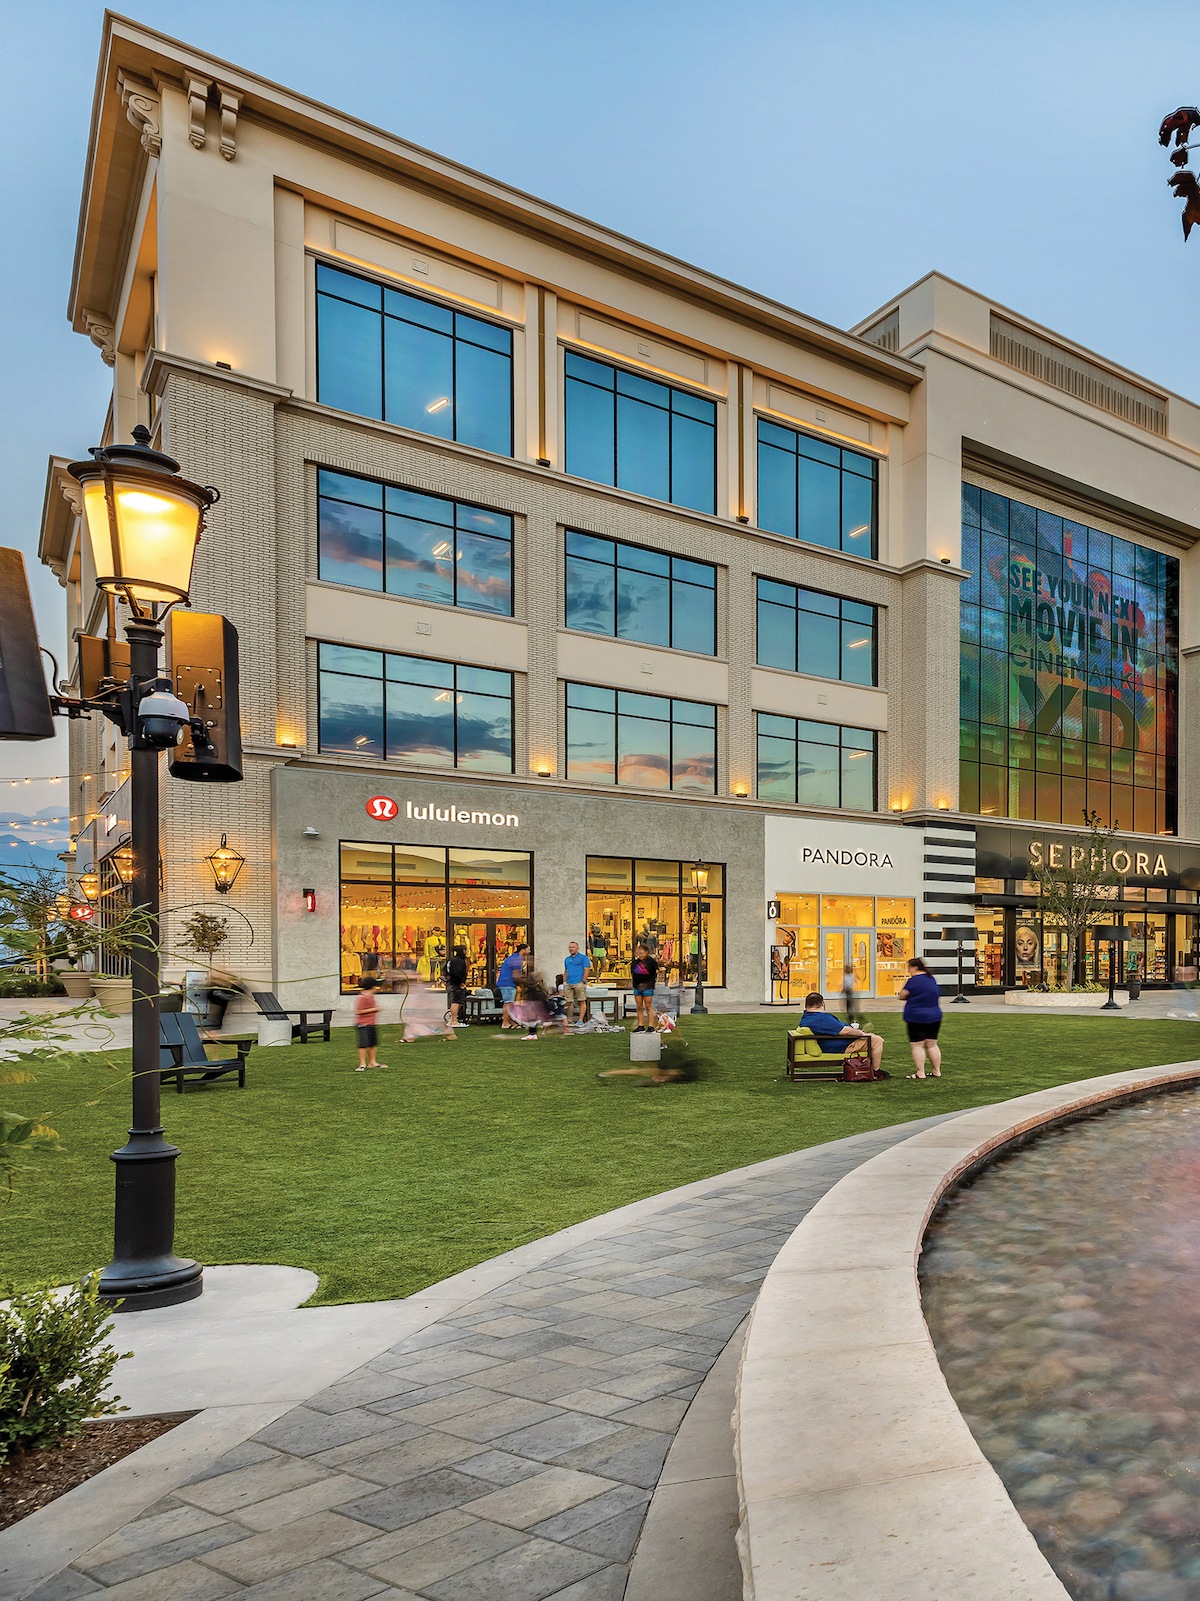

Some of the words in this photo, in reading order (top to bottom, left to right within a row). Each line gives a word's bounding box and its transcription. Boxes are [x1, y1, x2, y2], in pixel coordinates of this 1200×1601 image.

[1010, 563, 1042, 595] SEE
[1047, 574, 1094, 610] YOUR
[1099, 591, 1139, 623] NEXT
[1011, 593, 1102, 656] MOVIE
[1112, 622, 1138, 665] IN
[1010, 644, 1135, 692] CINEMARK
[406, 801, 520, 827] lululemon
[802, 847, 893, 868] PANDORA
[1029, 841, 1168, 877] SEPHORA
[881, 915, 907, 925] PANDORA
